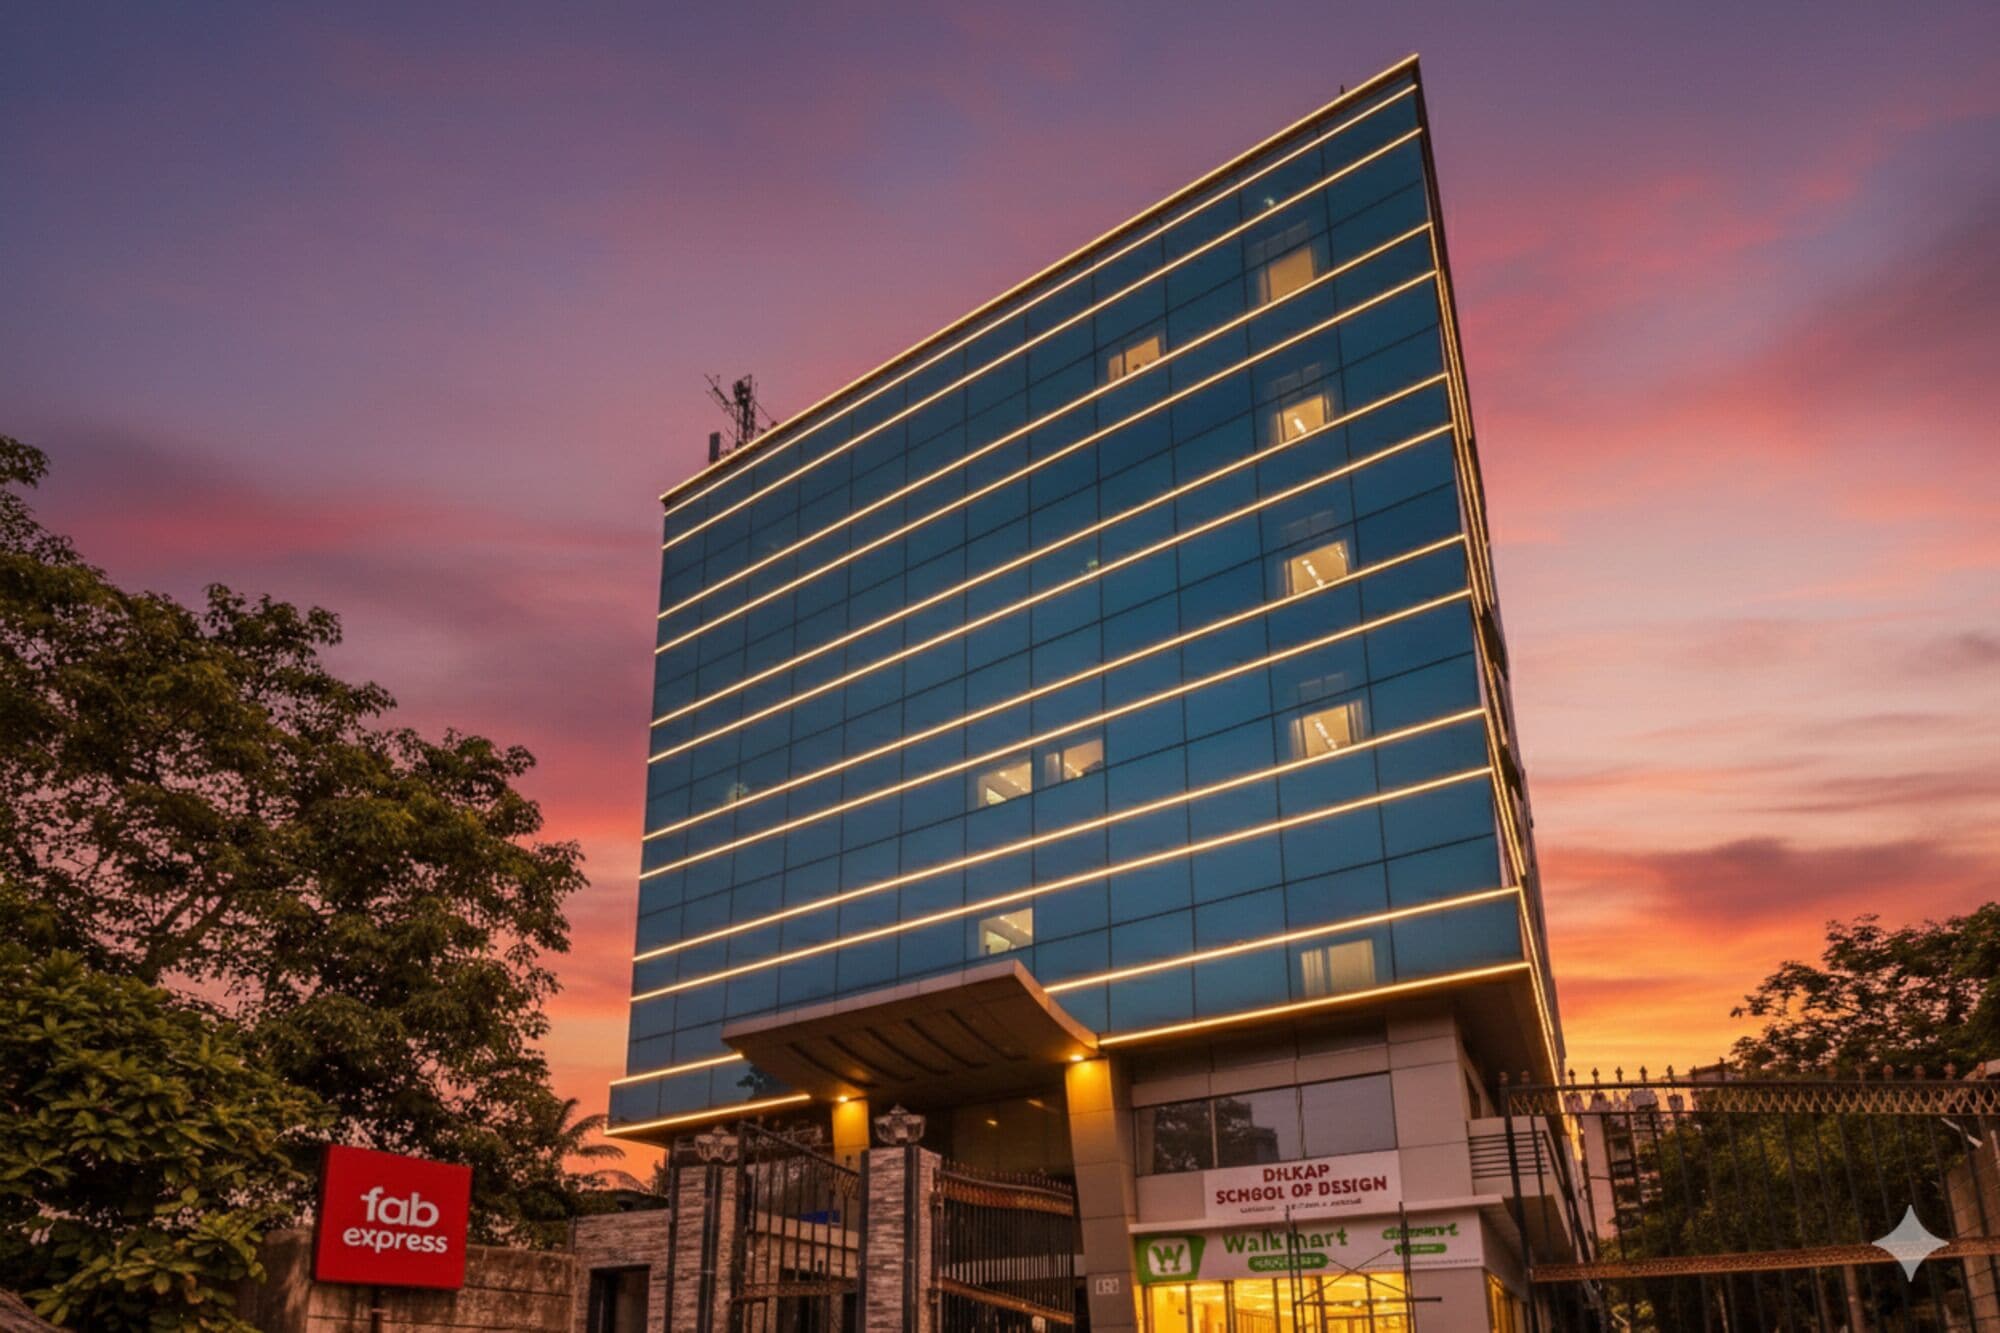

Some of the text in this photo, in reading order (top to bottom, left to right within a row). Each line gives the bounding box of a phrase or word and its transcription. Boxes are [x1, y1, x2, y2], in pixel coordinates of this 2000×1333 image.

[1216, 1186, 1284, 1205] SCHOOL
[1318, 1175, 1388, 1197] DESIGN
[360, 1186, 439, 1228] fab
[342, 1227, 448, 1254] express
[1151, 1243, 1185, 1273] W
